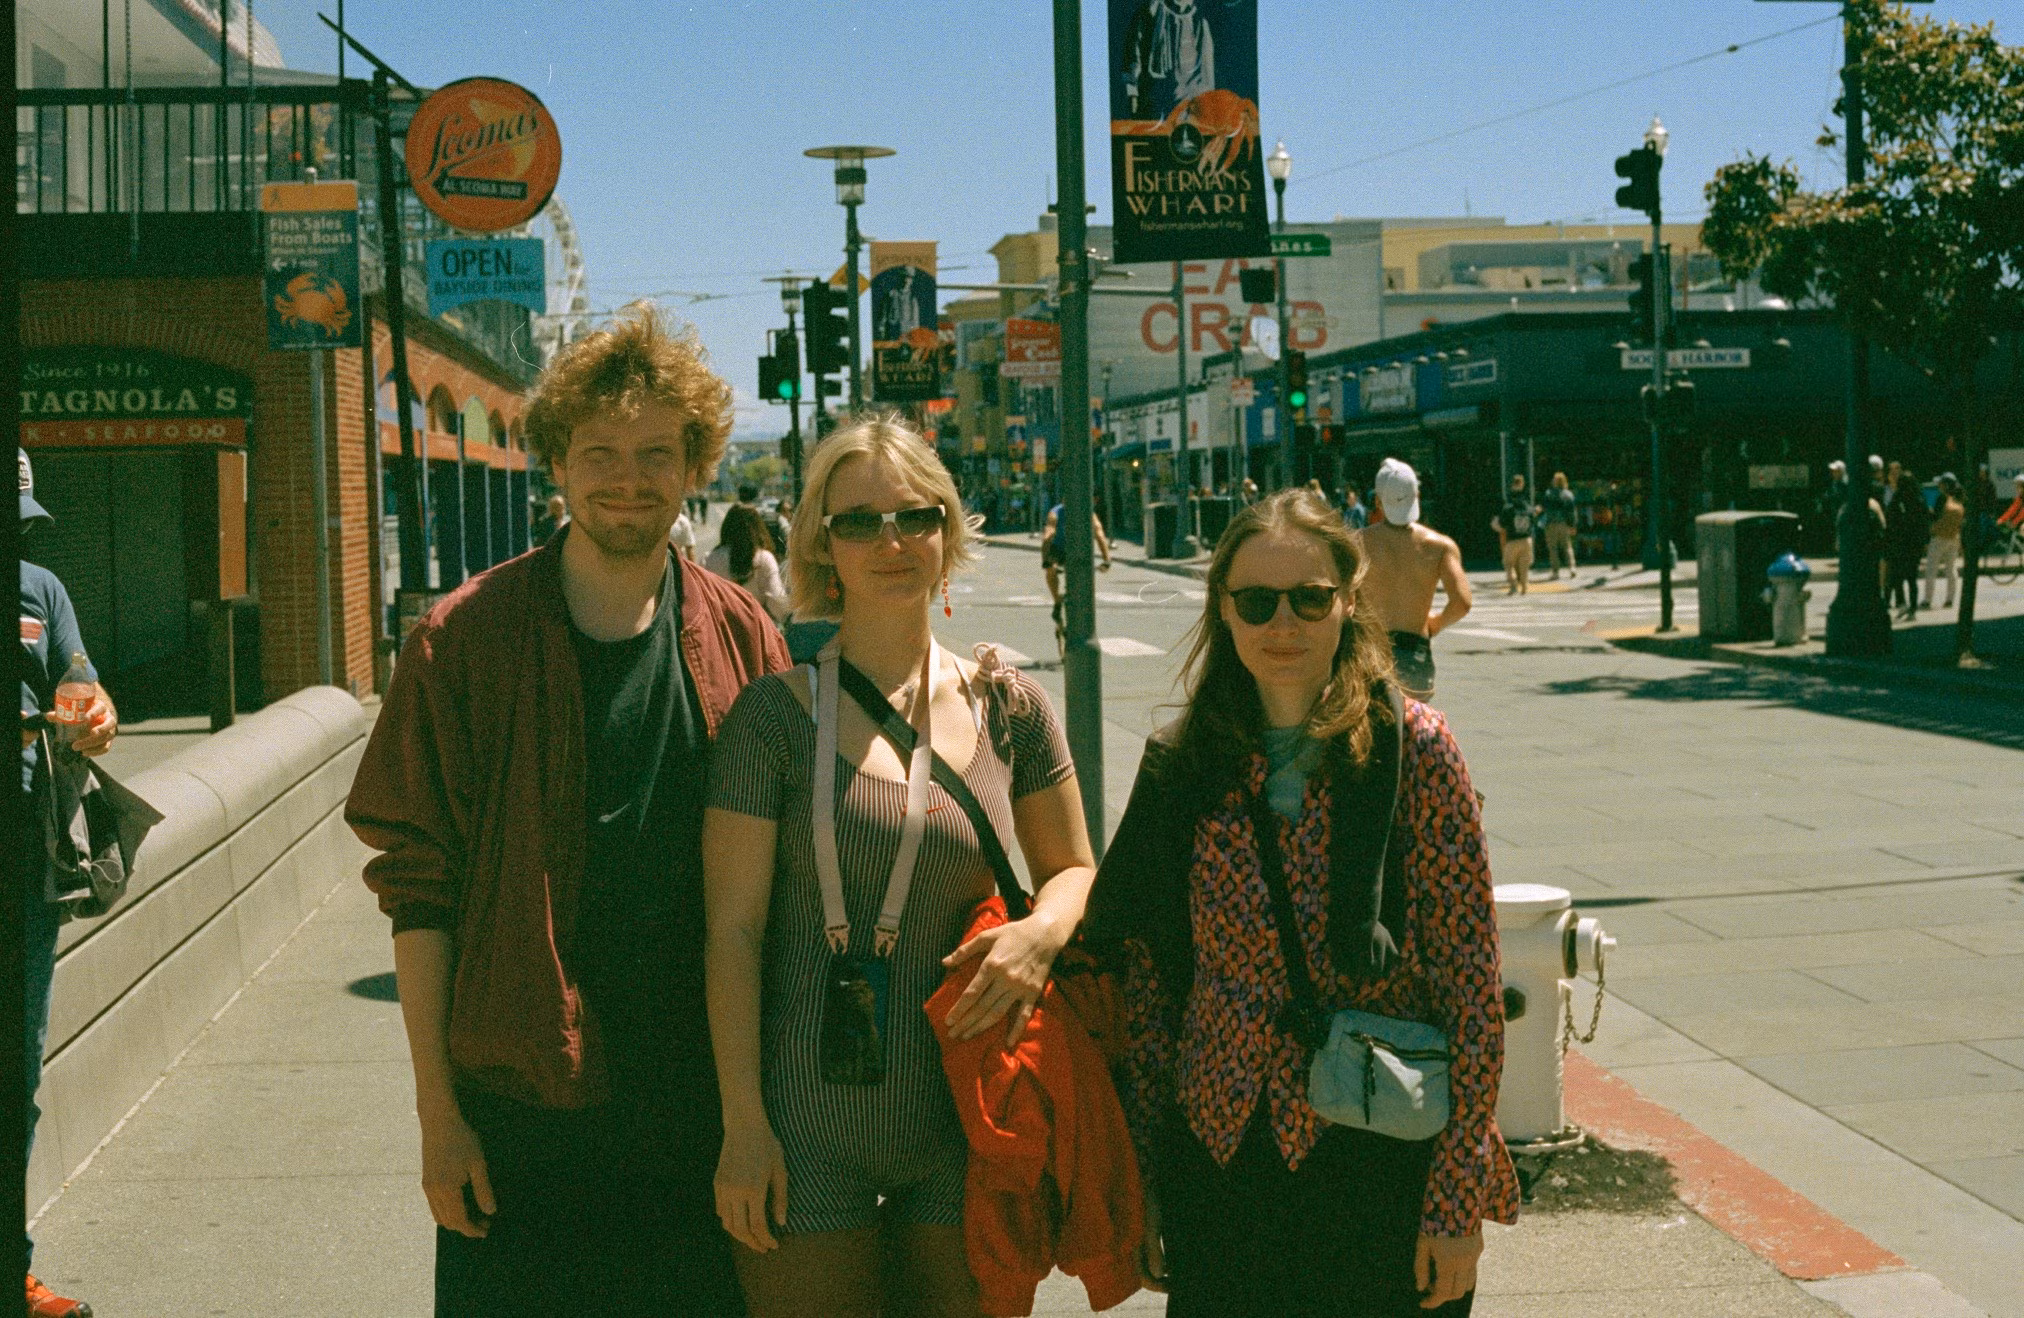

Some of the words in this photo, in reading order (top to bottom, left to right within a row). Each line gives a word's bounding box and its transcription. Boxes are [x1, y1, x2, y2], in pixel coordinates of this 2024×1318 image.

[270, 217, 300, 231] Fish
[303, 216, 342, 231] Sales
[270, 232, 308, 245] From
[312, 231, 353, 245] Boats
[442, 249, 513, 277] OPEN
[23, 362, 87, 381] Since
[95, 362, 151, 378] 1916
[19, 385, 238, 413] TAGNOLA'S
[84, 424, 227, 441] SEAFOOD
